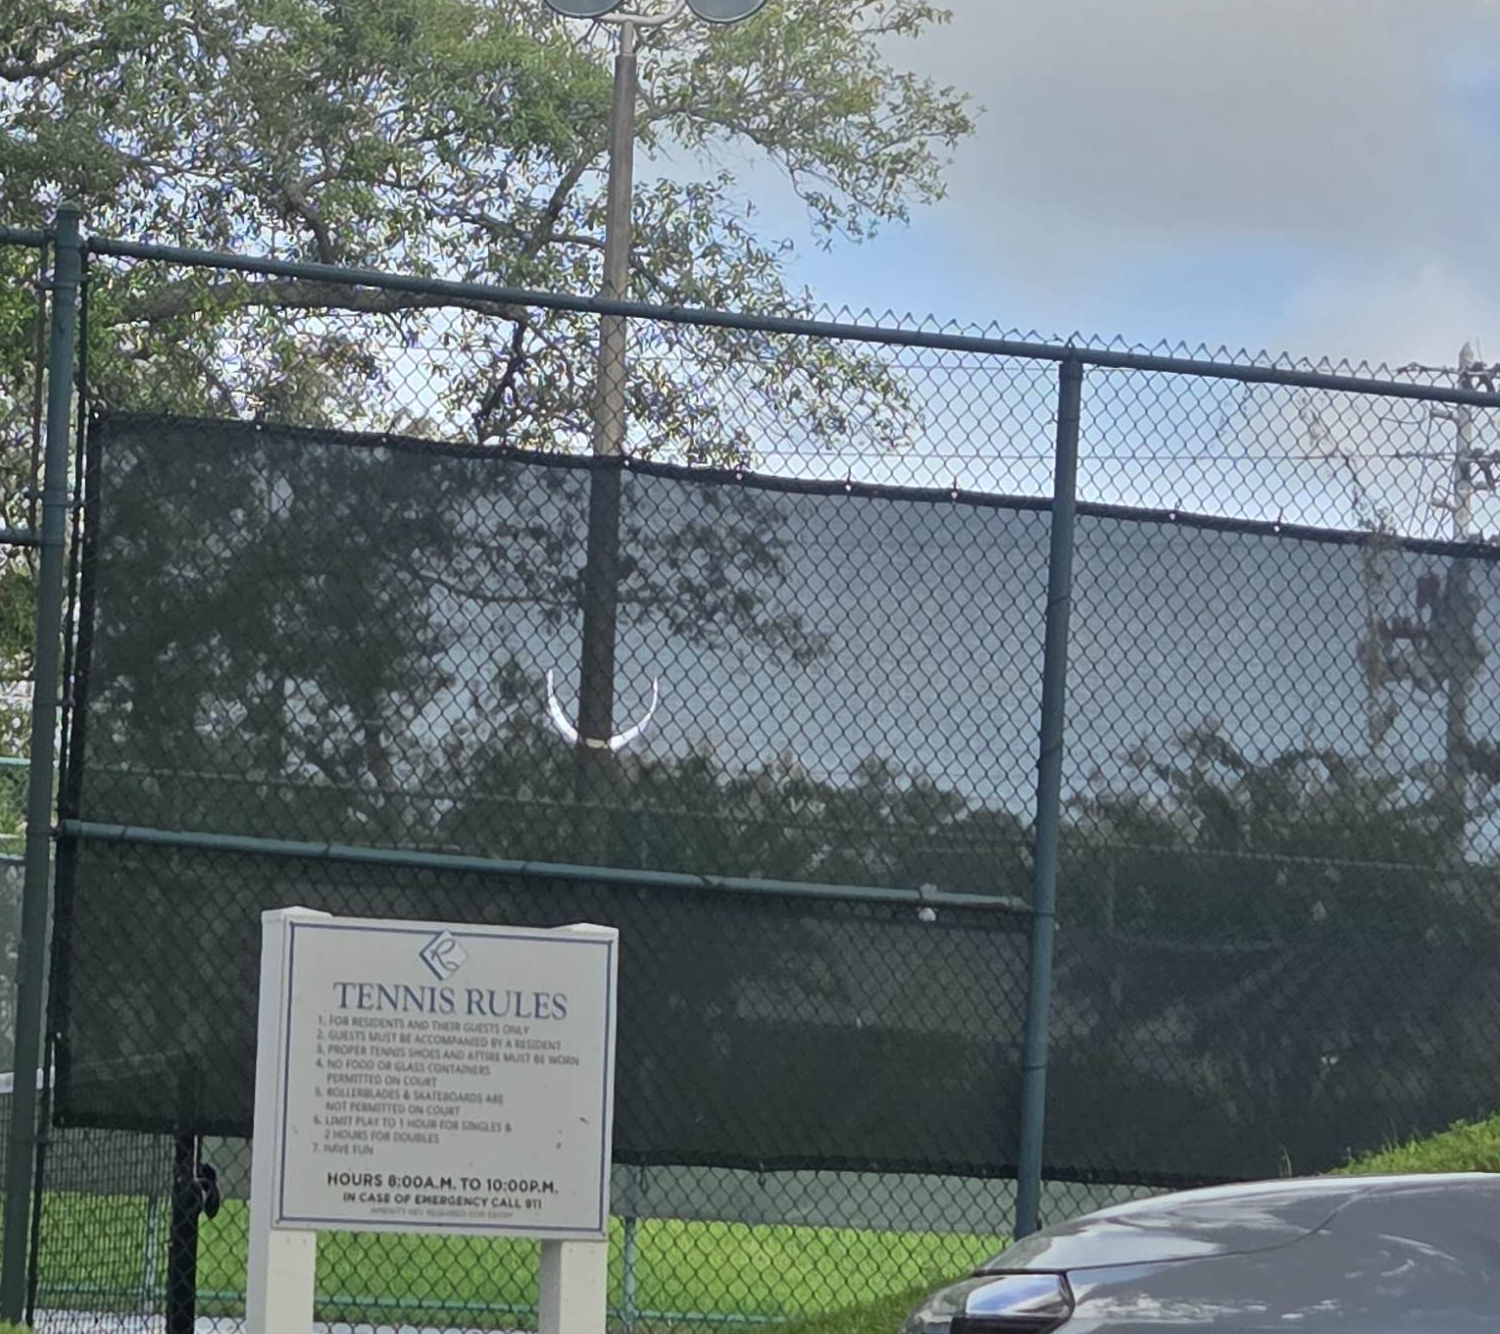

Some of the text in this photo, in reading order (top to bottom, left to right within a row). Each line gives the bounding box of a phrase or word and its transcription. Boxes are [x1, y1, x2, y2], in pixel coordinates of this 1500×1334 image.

[333, 981, 568, 1020] TENNIS RULES
[328, 1015, 349, 1026] FOR
[351, 1016, 405, 1029] RESIDENTS
[407, 1019, 429, 1030] AND
[432, 1021, 461, 1032] THEIR
[463, 1022, 500, 1034] GUESTS
[502, 1024, 531, 1035] ONLY
[316, 1028, 562, 1051] 2. GUESTS MUST BE ACCOMPANIED BY A RESIDENT
[327, 1044, 367, 1056] PROPER
[369, 1046, 406, 1057] TENNIS
[408, 1048, 440, 1059] SHOES
[443, 1050, 465, 1060] AND
[467, 1051, 500, 1063] ATTIRE
[503, 1053, 531, 1064] MUST
[533, 1054, 545, 1065] BE
[547, 1055, 580, 1066] WORN
[326, 1058, 343, 1069] NO
[345, 1060, 374, 1070] FOOD
[377, 1060, 392, 1071] OR
[394, 1062, 425, 1072] GLASS
[427, 1063, 491, 1075] CONTAINERS
[326, 1073, 438, 1087] PERMITTED ON COURT
[326, 1087, 400, 1100] ROLLERBLADES
[413, 1090, 483, 1104] SKATEBOARDS
[485, 1094, 504, 1105] ARE
[325, 1101, 460, 1116] NOT PERMITTED ON COURT
[325, 1116, 353, 1126] LIMIT
[355, 1116, 380, 1127] PLAY
[382, 1117, 396, 1128] TO
[399, 1118, 404, 1128] 1
[406, 1119, 437, 1129] HOUR
[439, 1120, 459, 1130] FOR
[461, 1121, 502, 1132] SINGLES
[323, 1130, 440, 1144] 2 HOURS FOR DOUBLES
[323, 1143, 350, 1154] HAVE
[352, 1145, 374, 1155] FUN
[327, 1172, 559, 1194] HOURS 8:00A.M. TO 10:00P.M.
[342, 1192, 356, 1202] IN
[359, 1192, 390, 1204] CASE
[394, 1193, 412, 1205] OF
[414, 1195, 489, 1208] EMERGENCY
[491, 1198, 522, 1208] CALL
